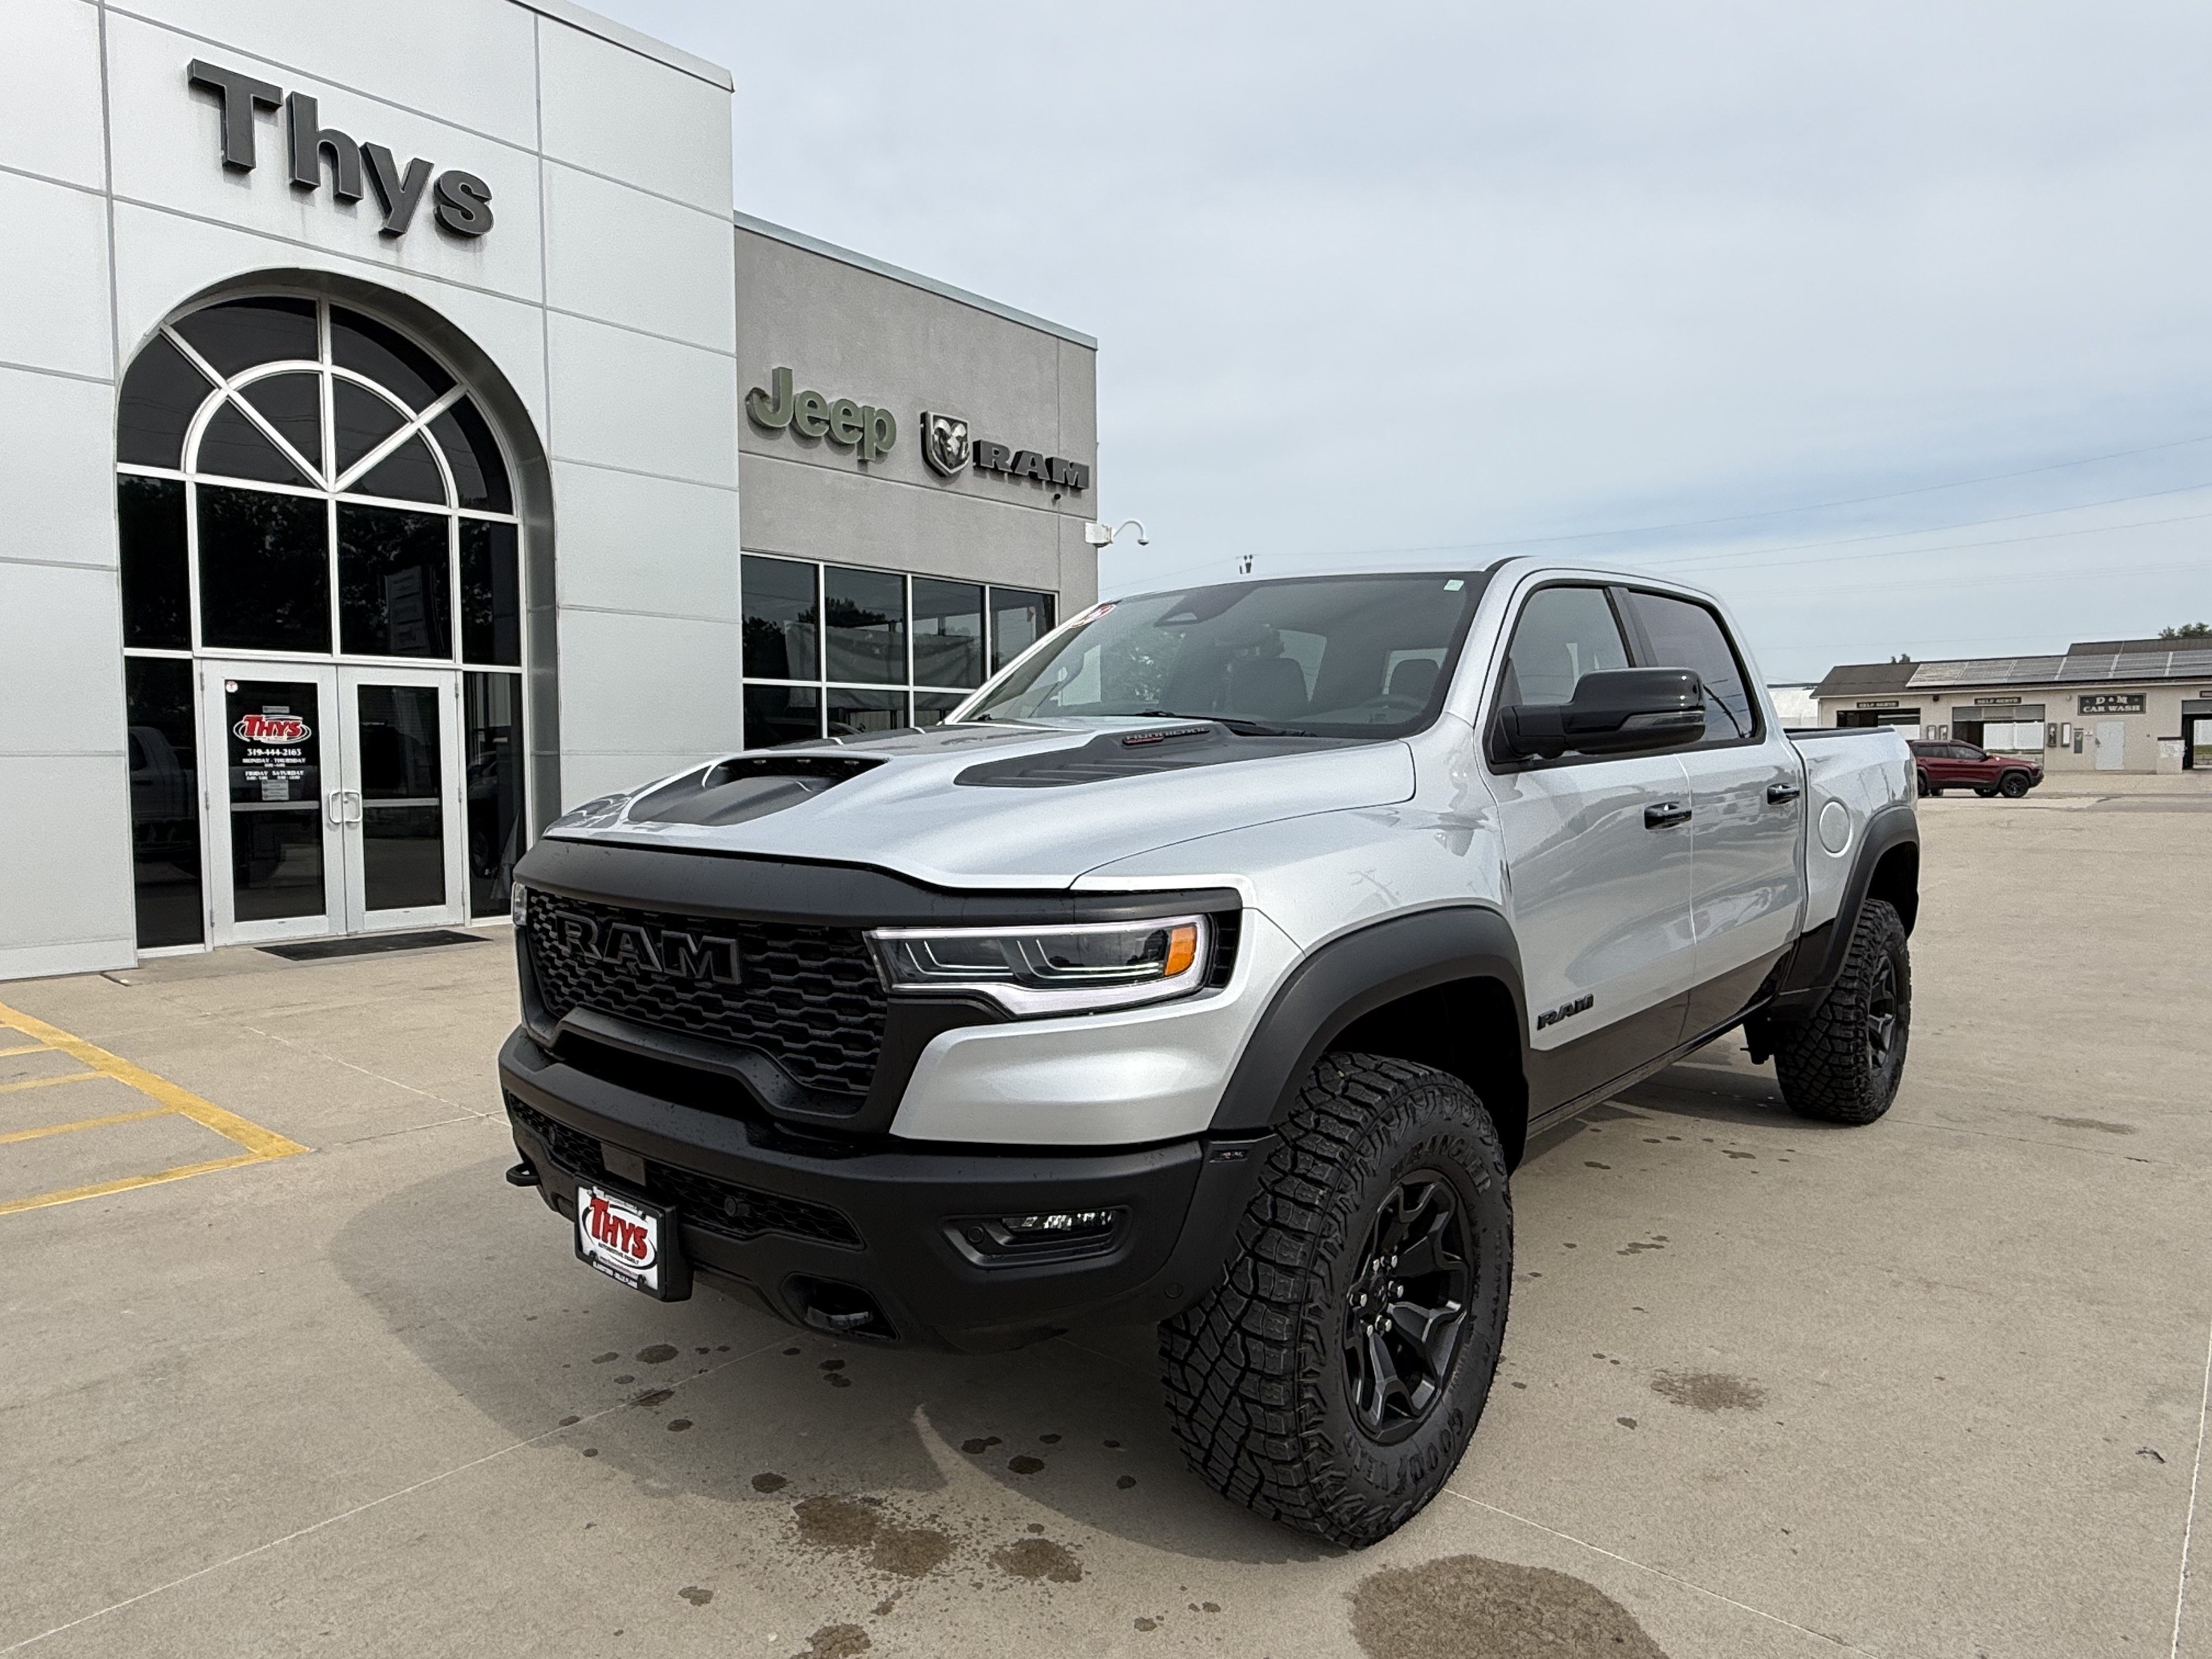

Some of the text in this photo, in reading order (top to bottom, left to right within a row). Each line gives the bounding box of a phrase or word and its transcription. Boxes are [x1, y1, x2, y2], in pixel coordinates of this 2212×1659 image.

[187, 58, 494, 238] Thys
[747, 367, 897, 461] Jeep
[973, 439, 1091, 490] RAM
[245, 715, 301, 736] THYS
[2117, 696, 2128, 704] M
[555, 910, 742, 985] RAM
[1536, 993, 1594, 1031] RAM
[590, 1197, 648, 1260] THYS
